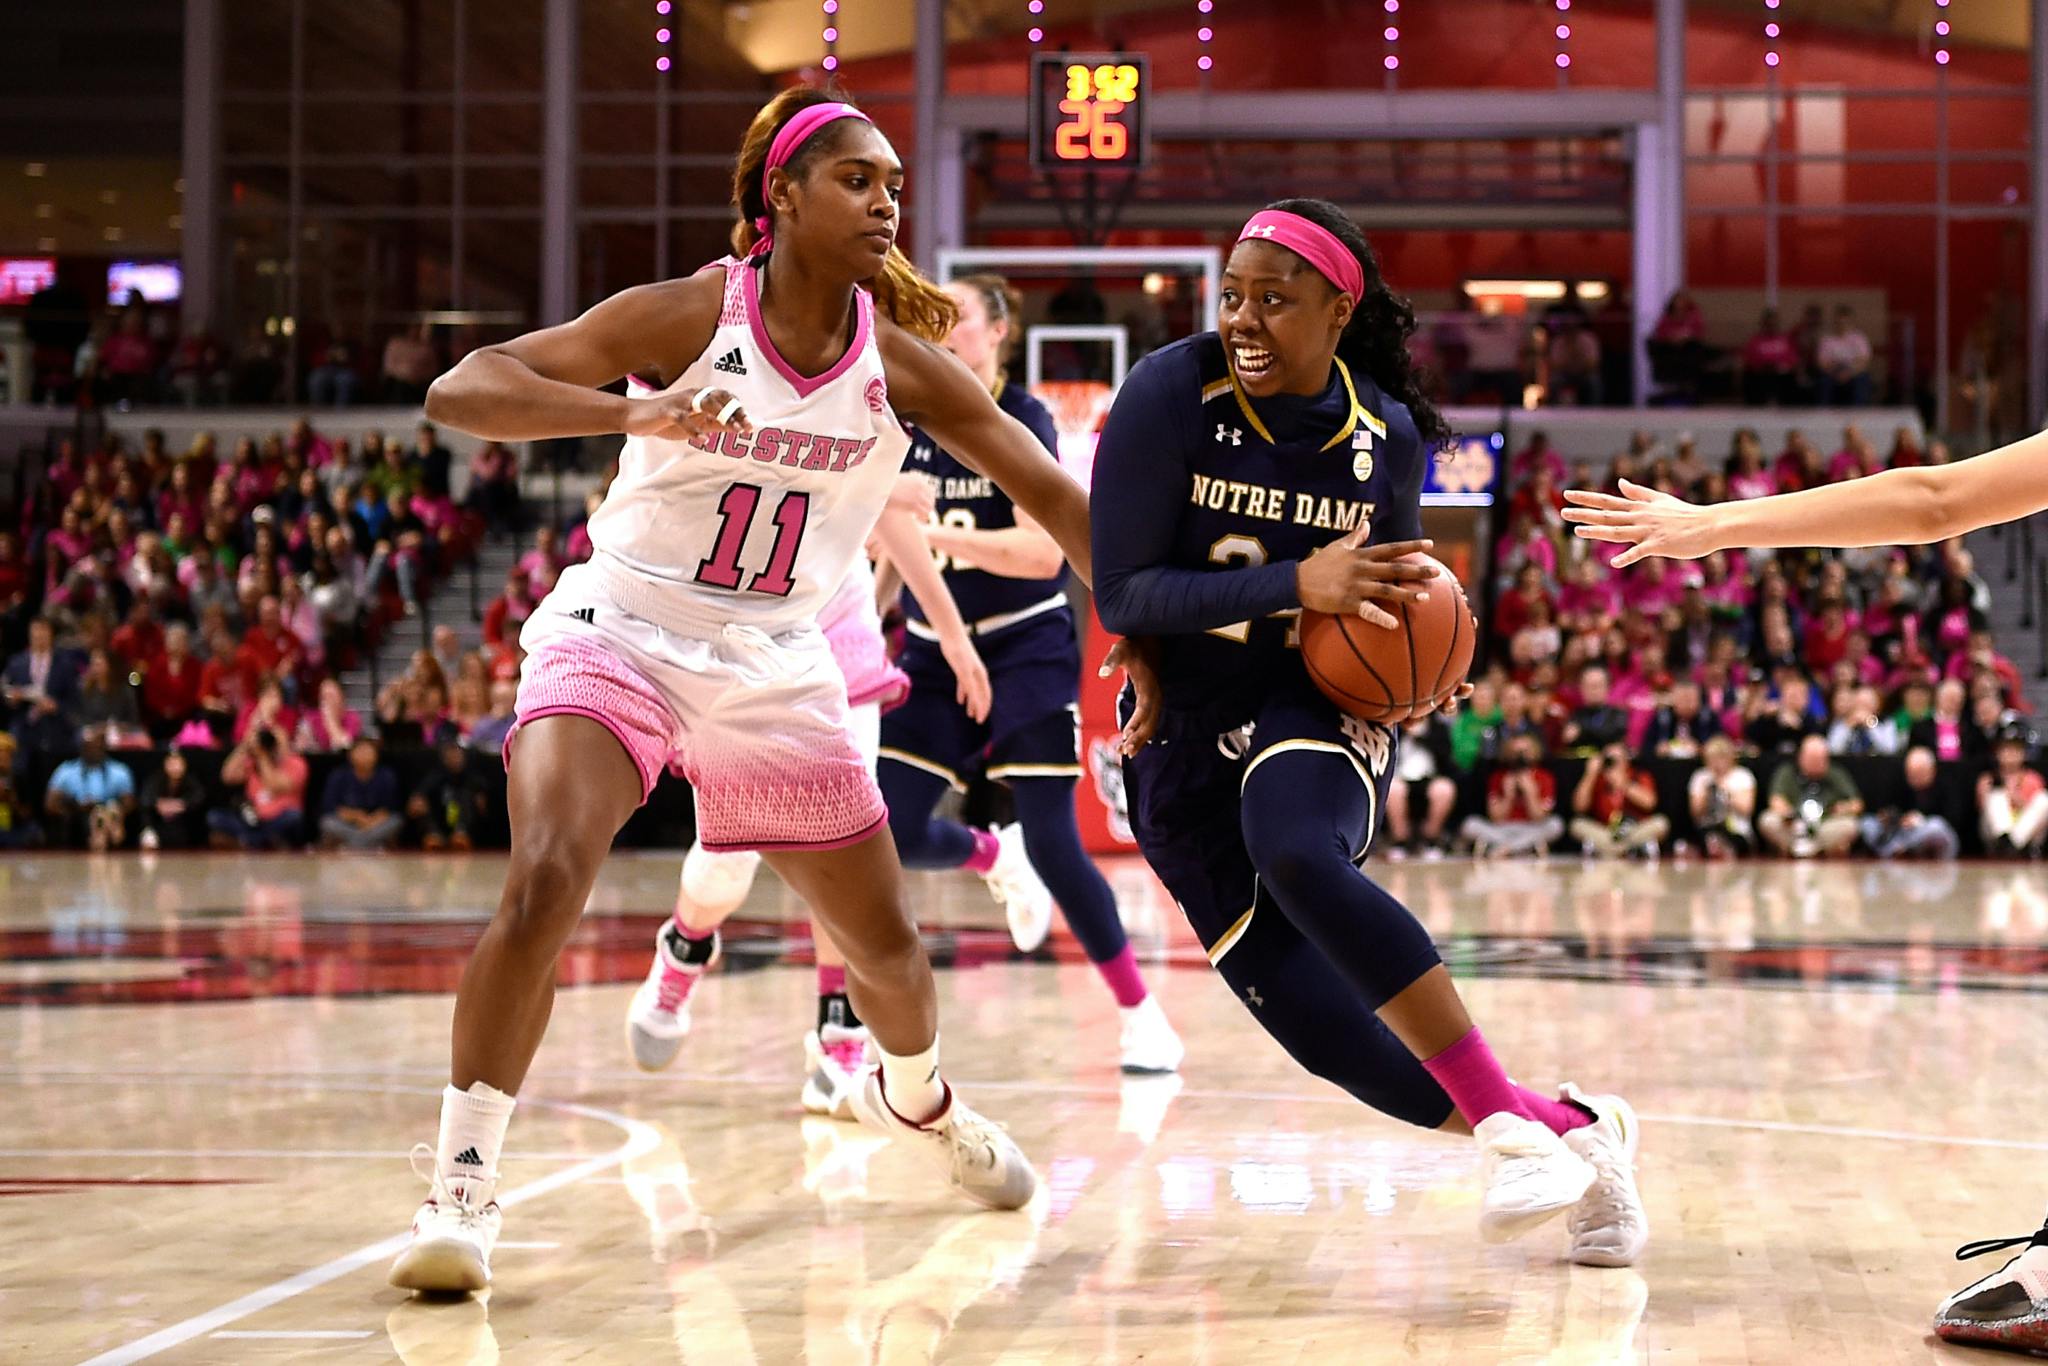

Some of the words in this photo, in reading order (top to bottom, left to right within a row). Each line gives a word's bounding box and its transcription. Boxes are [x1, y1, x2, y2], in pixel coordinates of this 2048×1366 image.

[1066, 65, 1139, 102] 3:52
[1056, 99, 1127, 159] 26
[714, 361, 747, 375] adidas
[1190, 473, 1286, 521] NOTRE
[694, 482, 810, 597] 11
